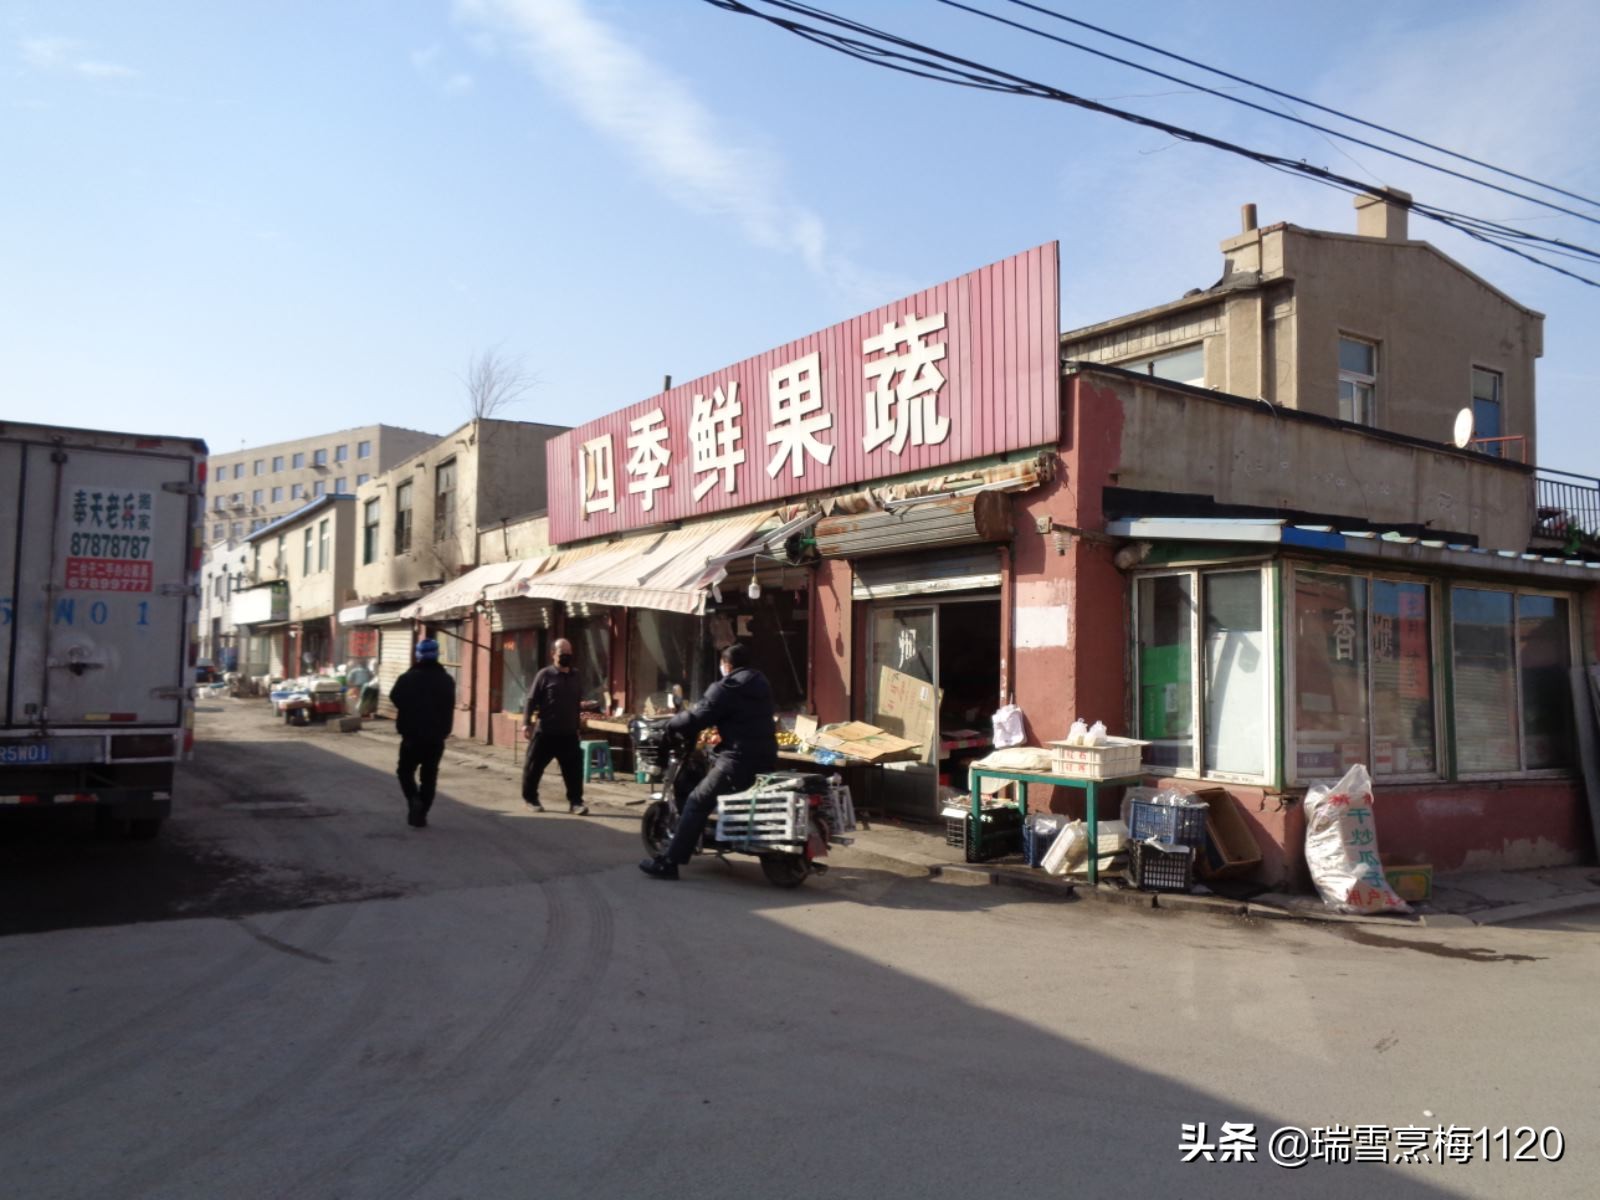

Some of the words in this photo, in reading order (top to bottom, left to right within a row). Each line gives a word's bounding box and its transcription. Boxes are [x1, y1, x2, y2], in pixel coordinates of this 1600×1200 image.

[579, 312, 951, 516] 四季鲜果蔬
[70, 532, 150, 558] 87878787
